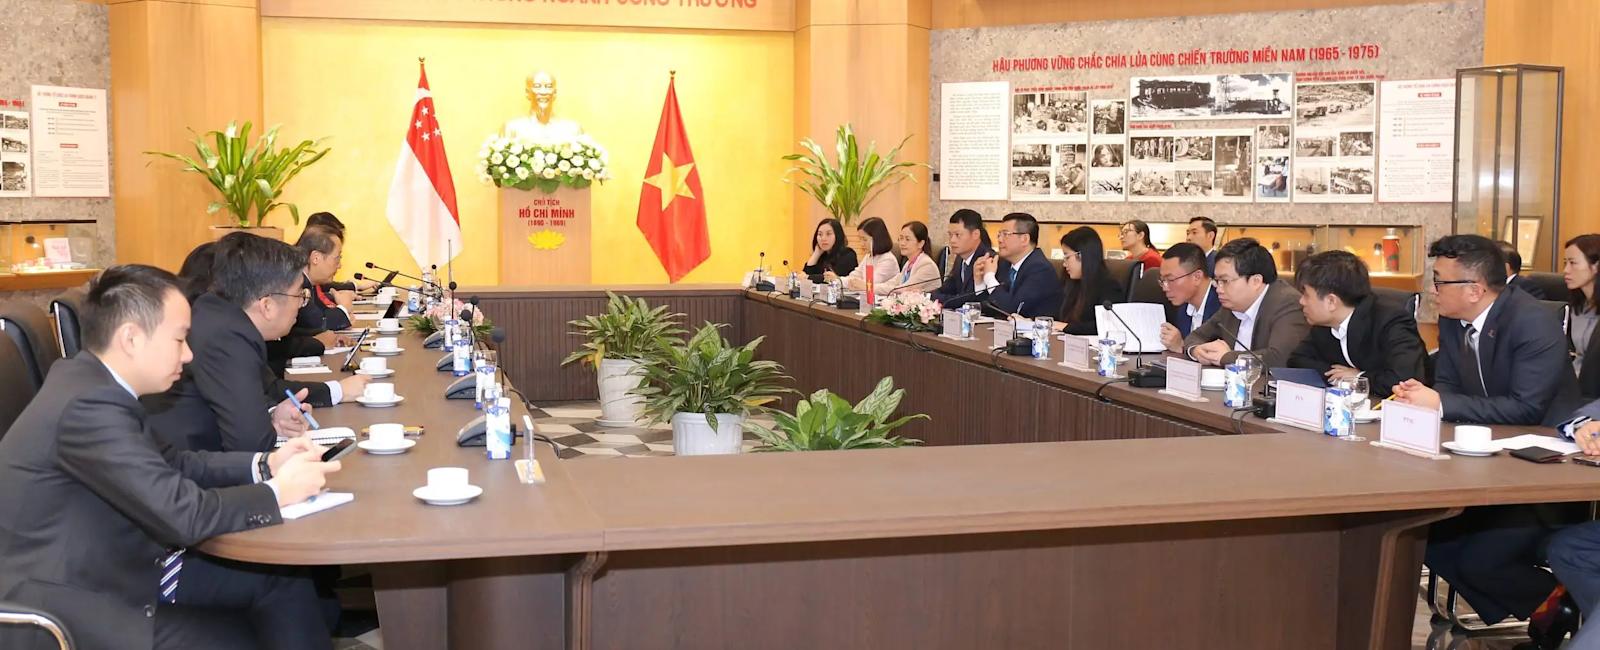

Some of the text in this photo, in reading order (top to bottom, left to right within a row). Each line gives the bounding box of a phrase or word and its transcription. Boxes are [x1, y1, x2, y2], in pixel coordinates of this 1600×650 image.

[992, 57, 1010, 73] HẬU
[1013, 57, 1048, 71] PHƯƠNG
[1051, 55, 1075, 70] VỮNG
[1078, 51, 1103, 68] CHẮC
[1130, 49, 1147, 67] LỬA
[1150, 51, 1175, 66] CÙNG
[1178, 48, 1206, 65] CHIẾN
[1210, 48, 1249, 64] TRƯỜNG
[1252, 45, 1278, 63] MIỀN
[1281, 48, 1305, 62] NAM
[1309, 46, 1339, 61] (1965
[1348, 44, 1379, 60] 1975)
[534, 197, 560, 207] CHỦ TỊCH
[519, 206, 575, 218] HỒ CHÍ MINH
